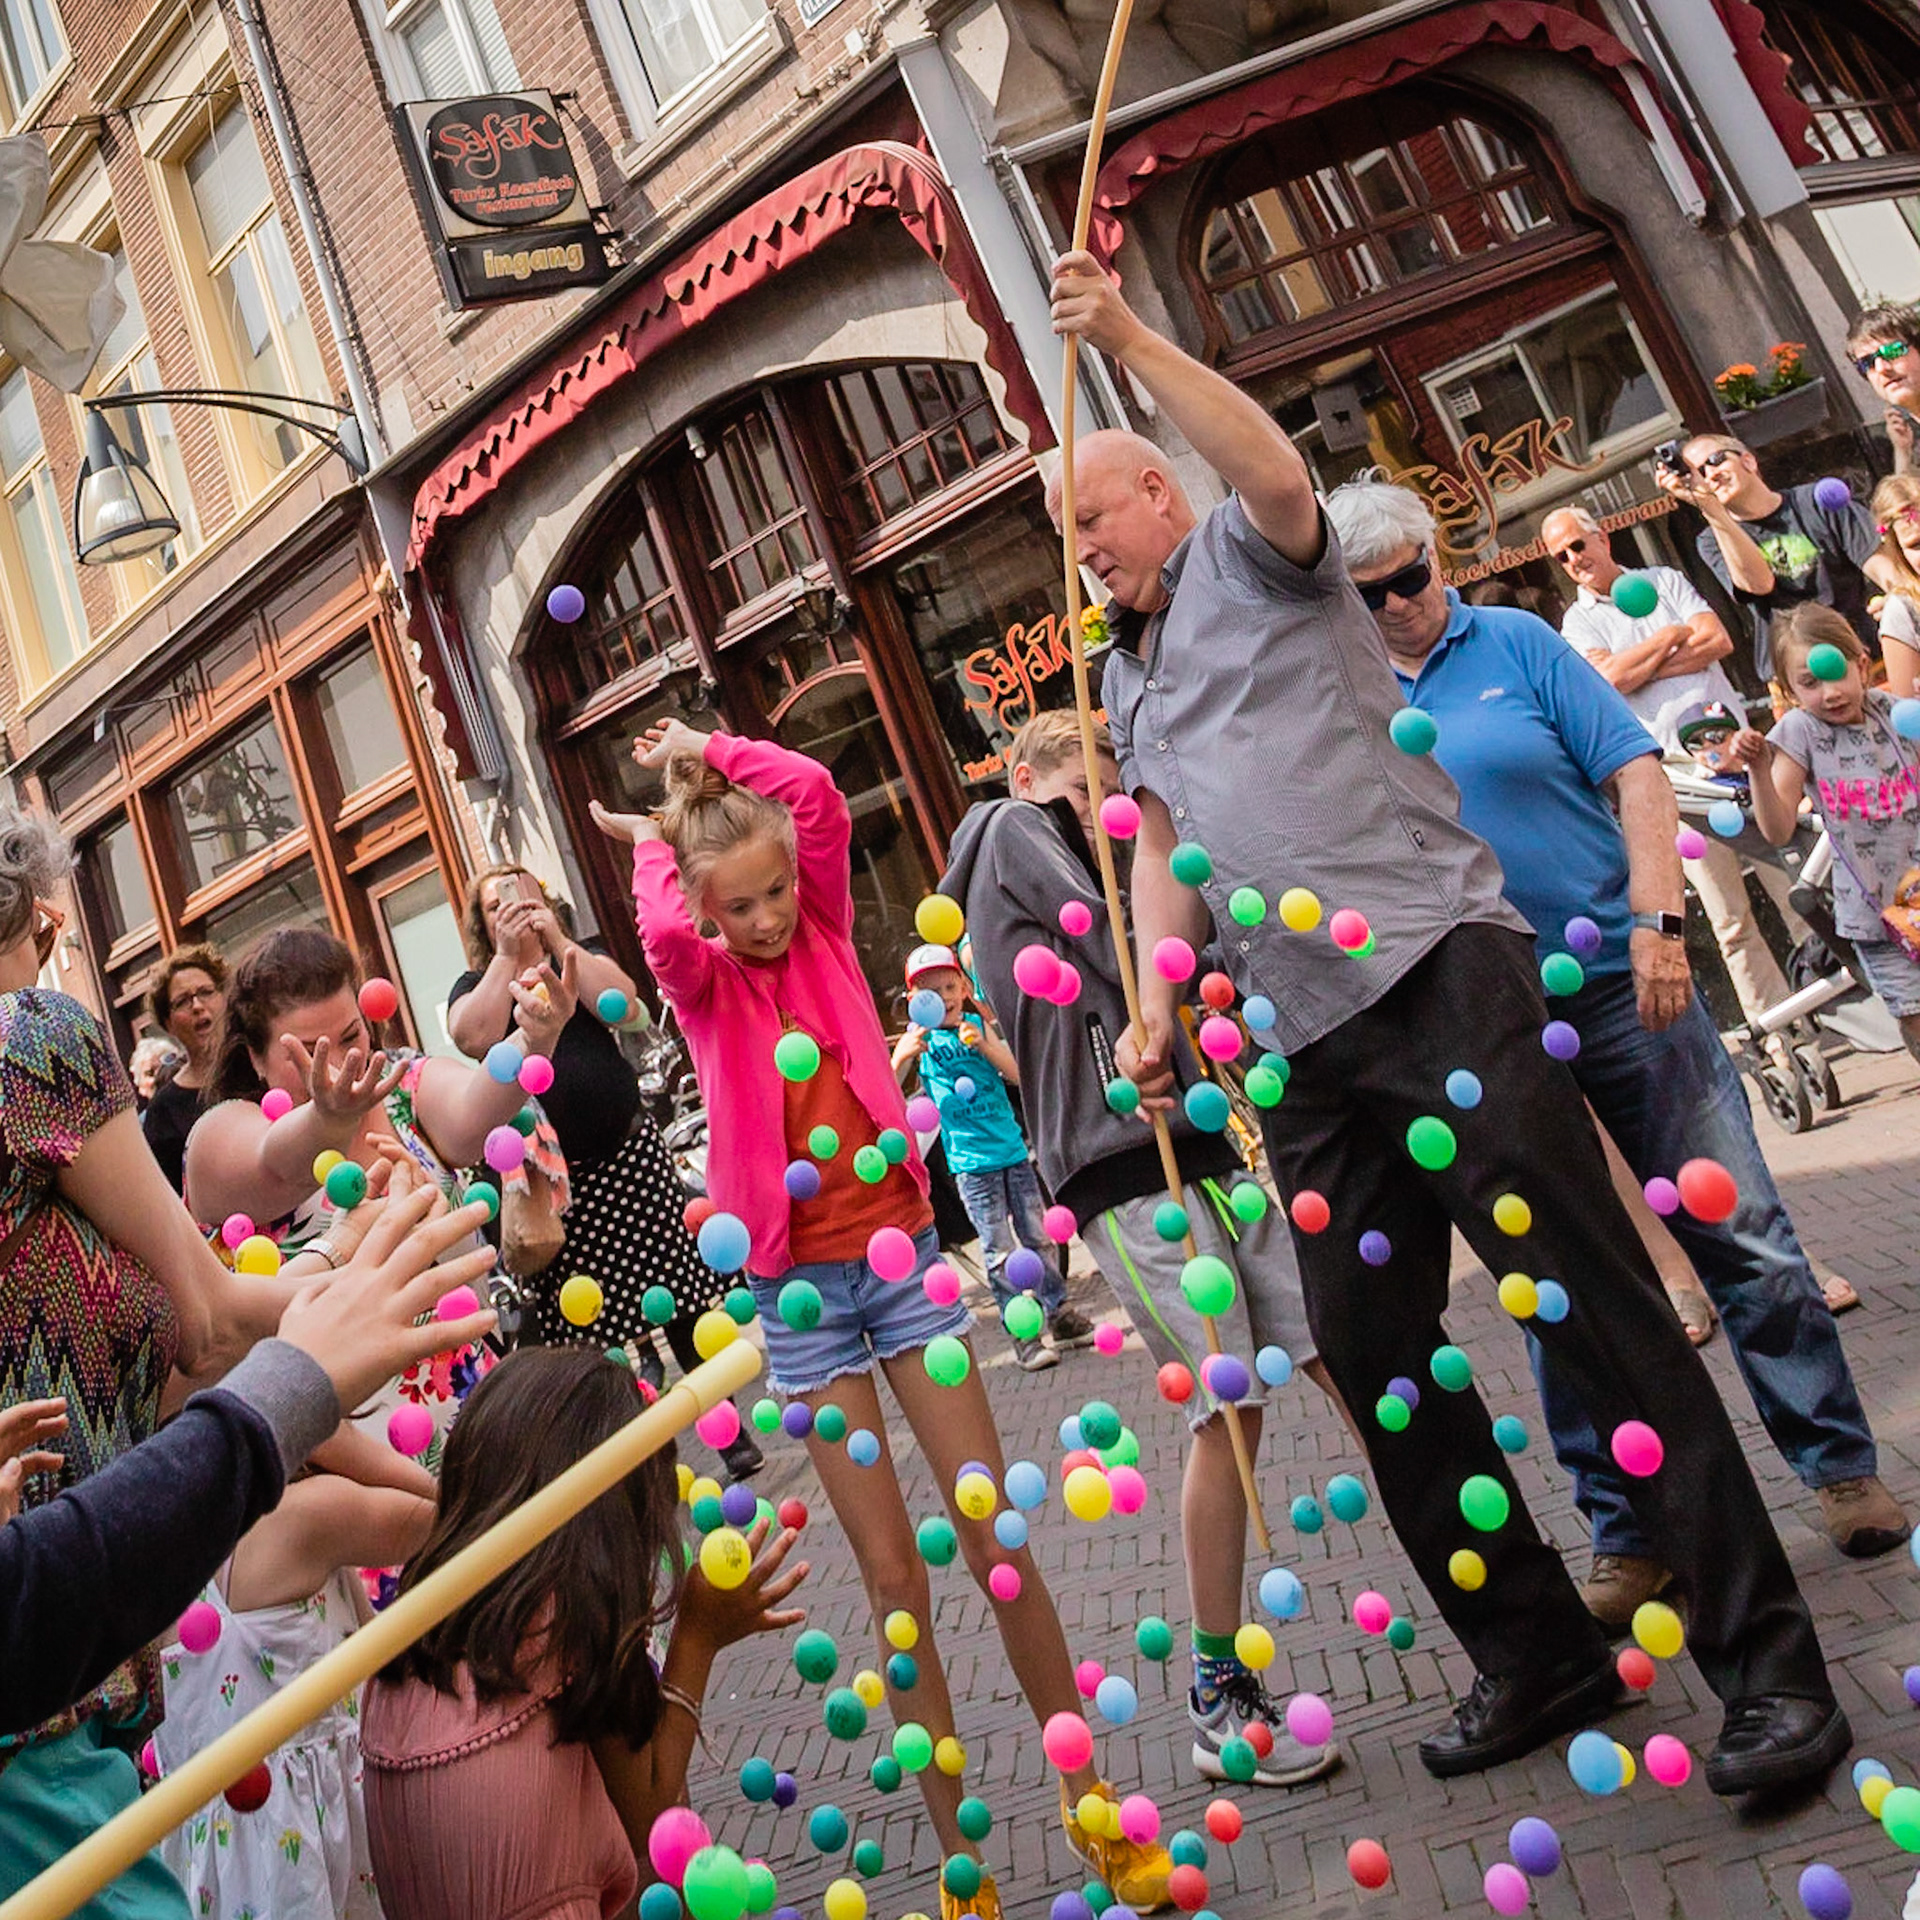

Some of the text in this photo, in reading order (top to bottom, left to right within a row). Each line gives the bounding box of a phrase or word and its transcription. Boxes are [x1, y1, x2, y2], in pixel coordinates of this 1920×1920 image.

[498, 174, 575, 199] Koerdisch
[476, 192, 560, 214] restaurant
[482, 243, 585, 280] ingang
[1600, 492, 1679, 533] aurant
